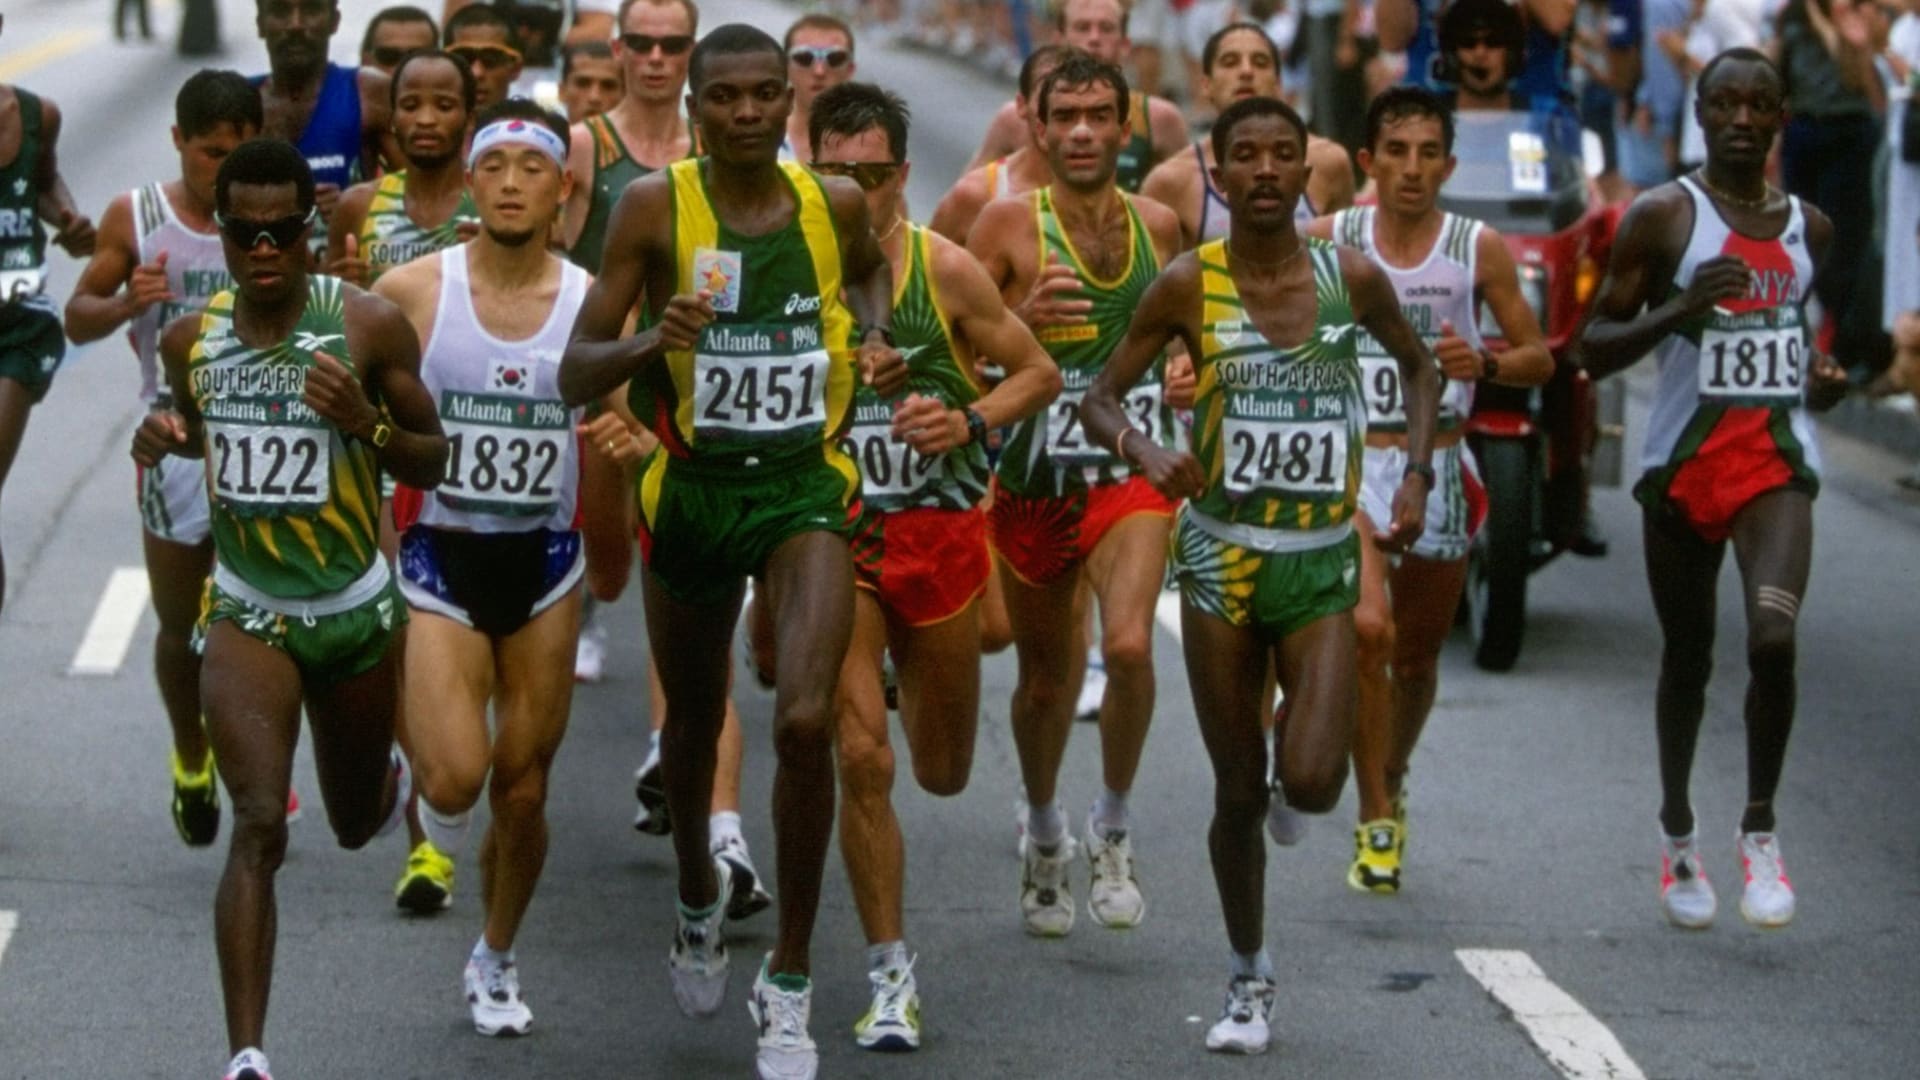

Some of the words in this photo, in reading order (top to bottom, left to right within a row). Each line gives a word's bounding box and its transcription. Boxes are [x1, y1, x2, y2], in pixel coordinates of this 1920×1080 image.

[1405, 286, 1451, 298] adidas
[704, 327, 772, 352] Atlanta
[792, 325, 818, 350] 1996
[1215, 361, 1279, 388] SOUTH
[1708, 337, 1800, 389] 1819
[194, 366, 250, 394] SOUTH
[703, 363, 815, 424] 2451
[206, 398, 267, 422] Atlanta
[449, 395, 513, 423] Atlanta
[533, 403, 565, 426] 1996
[1230, 394, 1294, 418] Atlanta
[1314, 396, 1342, 418] 1996
[215, 432, 318, 495] 2122
[443, 433, 559, 497] 1832
[1231, 430, 1335, 485] 2481
